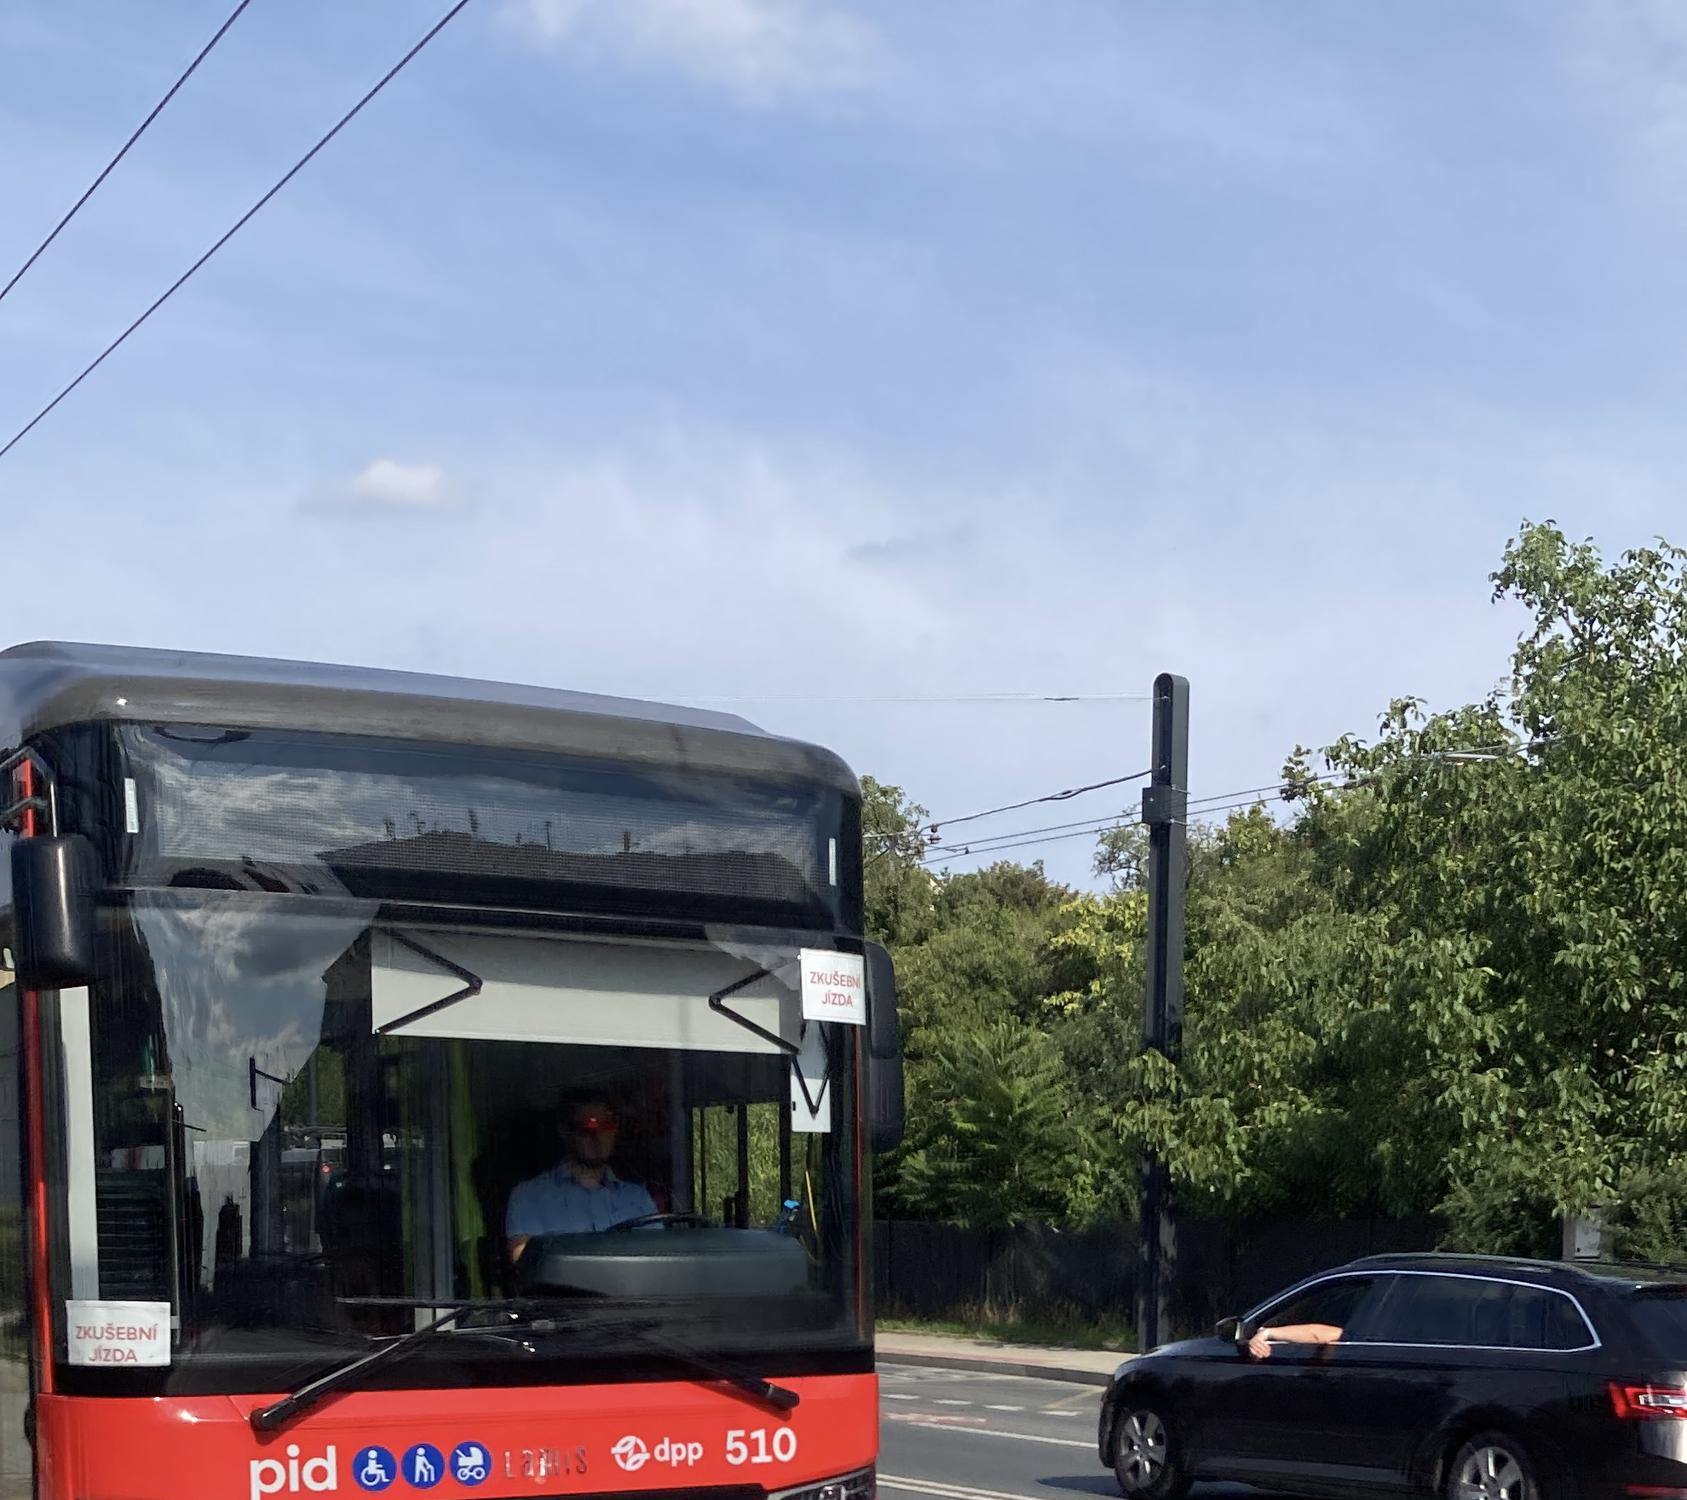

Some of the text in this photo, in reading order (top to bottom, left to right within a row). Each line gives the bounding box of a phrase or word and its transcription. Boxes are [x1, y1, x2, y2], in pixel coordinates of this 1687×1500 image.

[75, 1322, 159, 1341] ZKUŠEBNÍ
[89, 1344, 139, 1362] JÍZDA
[654, 1437, 704, 1467] dpp
[725, 1426, 798, 1466] 510
